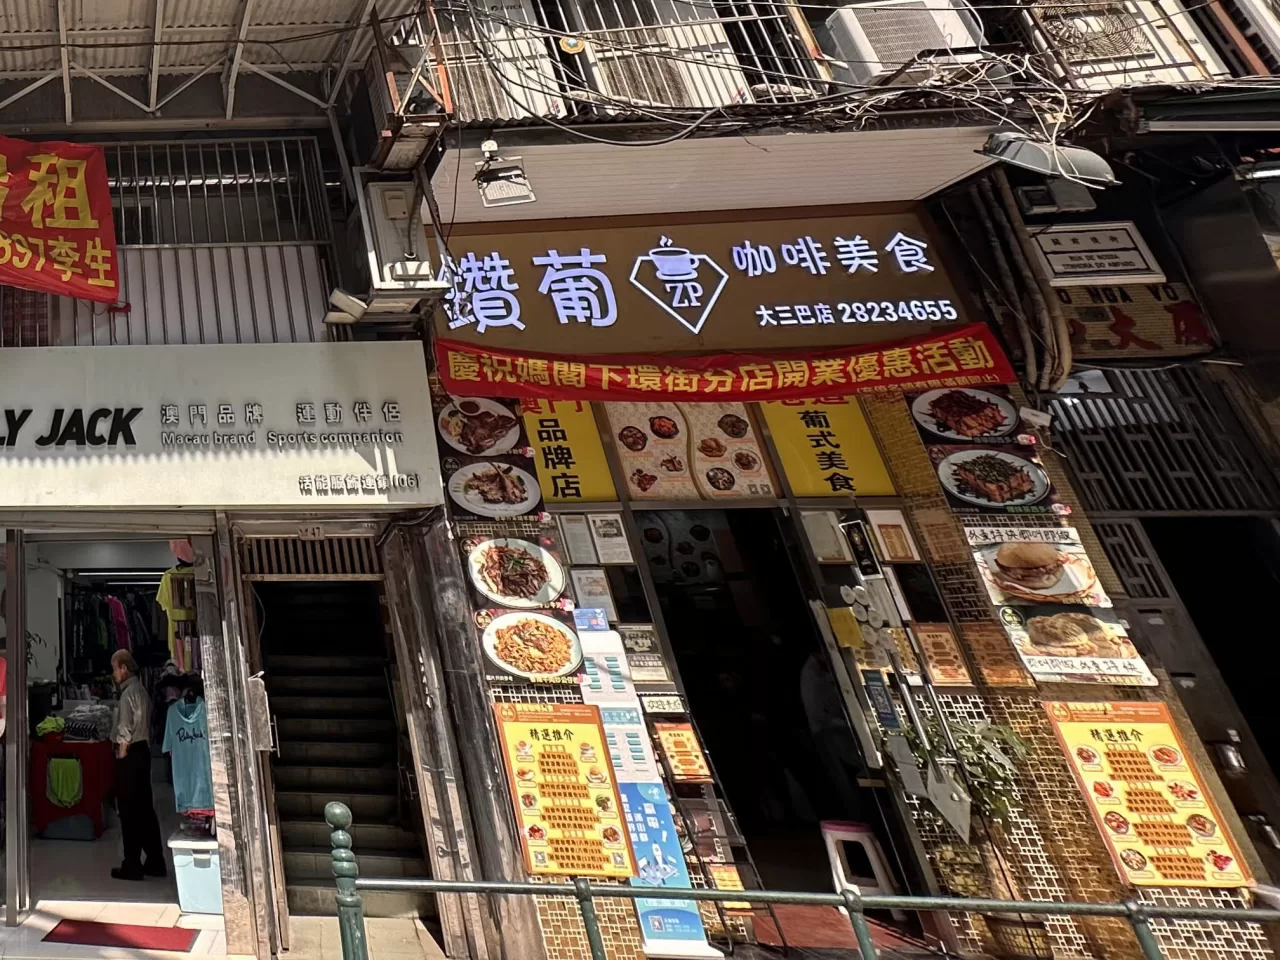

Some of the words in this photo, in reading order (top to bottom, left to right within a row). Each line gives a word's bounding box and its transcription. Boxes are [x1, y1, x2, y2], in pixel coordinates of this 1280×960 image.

[732, 231, 935, 277] 咖啡美食
[665, 282, 703, 307] ZP
[756, 304, 835, 326] 大三巴店
[837, 300, 958, 324] 28234655
[448, 336, 995, 393] 慶祝媽閣下環街分店開業優惠活動
[35, 408, 144, 446] JACK
[161, 404, 264, 425] 澳門品牌
[297, 402, 401, 424] 運動伴侶
[162, 432, 209, 445] Macau
[214, 431, 256, 444] brand
[267, 431, 317, 447] Sports
[321, 430, 404, 446] companion
[797, 410, 856, 492] 葡式美食
[537, 418, 582, 498] 品牌店
